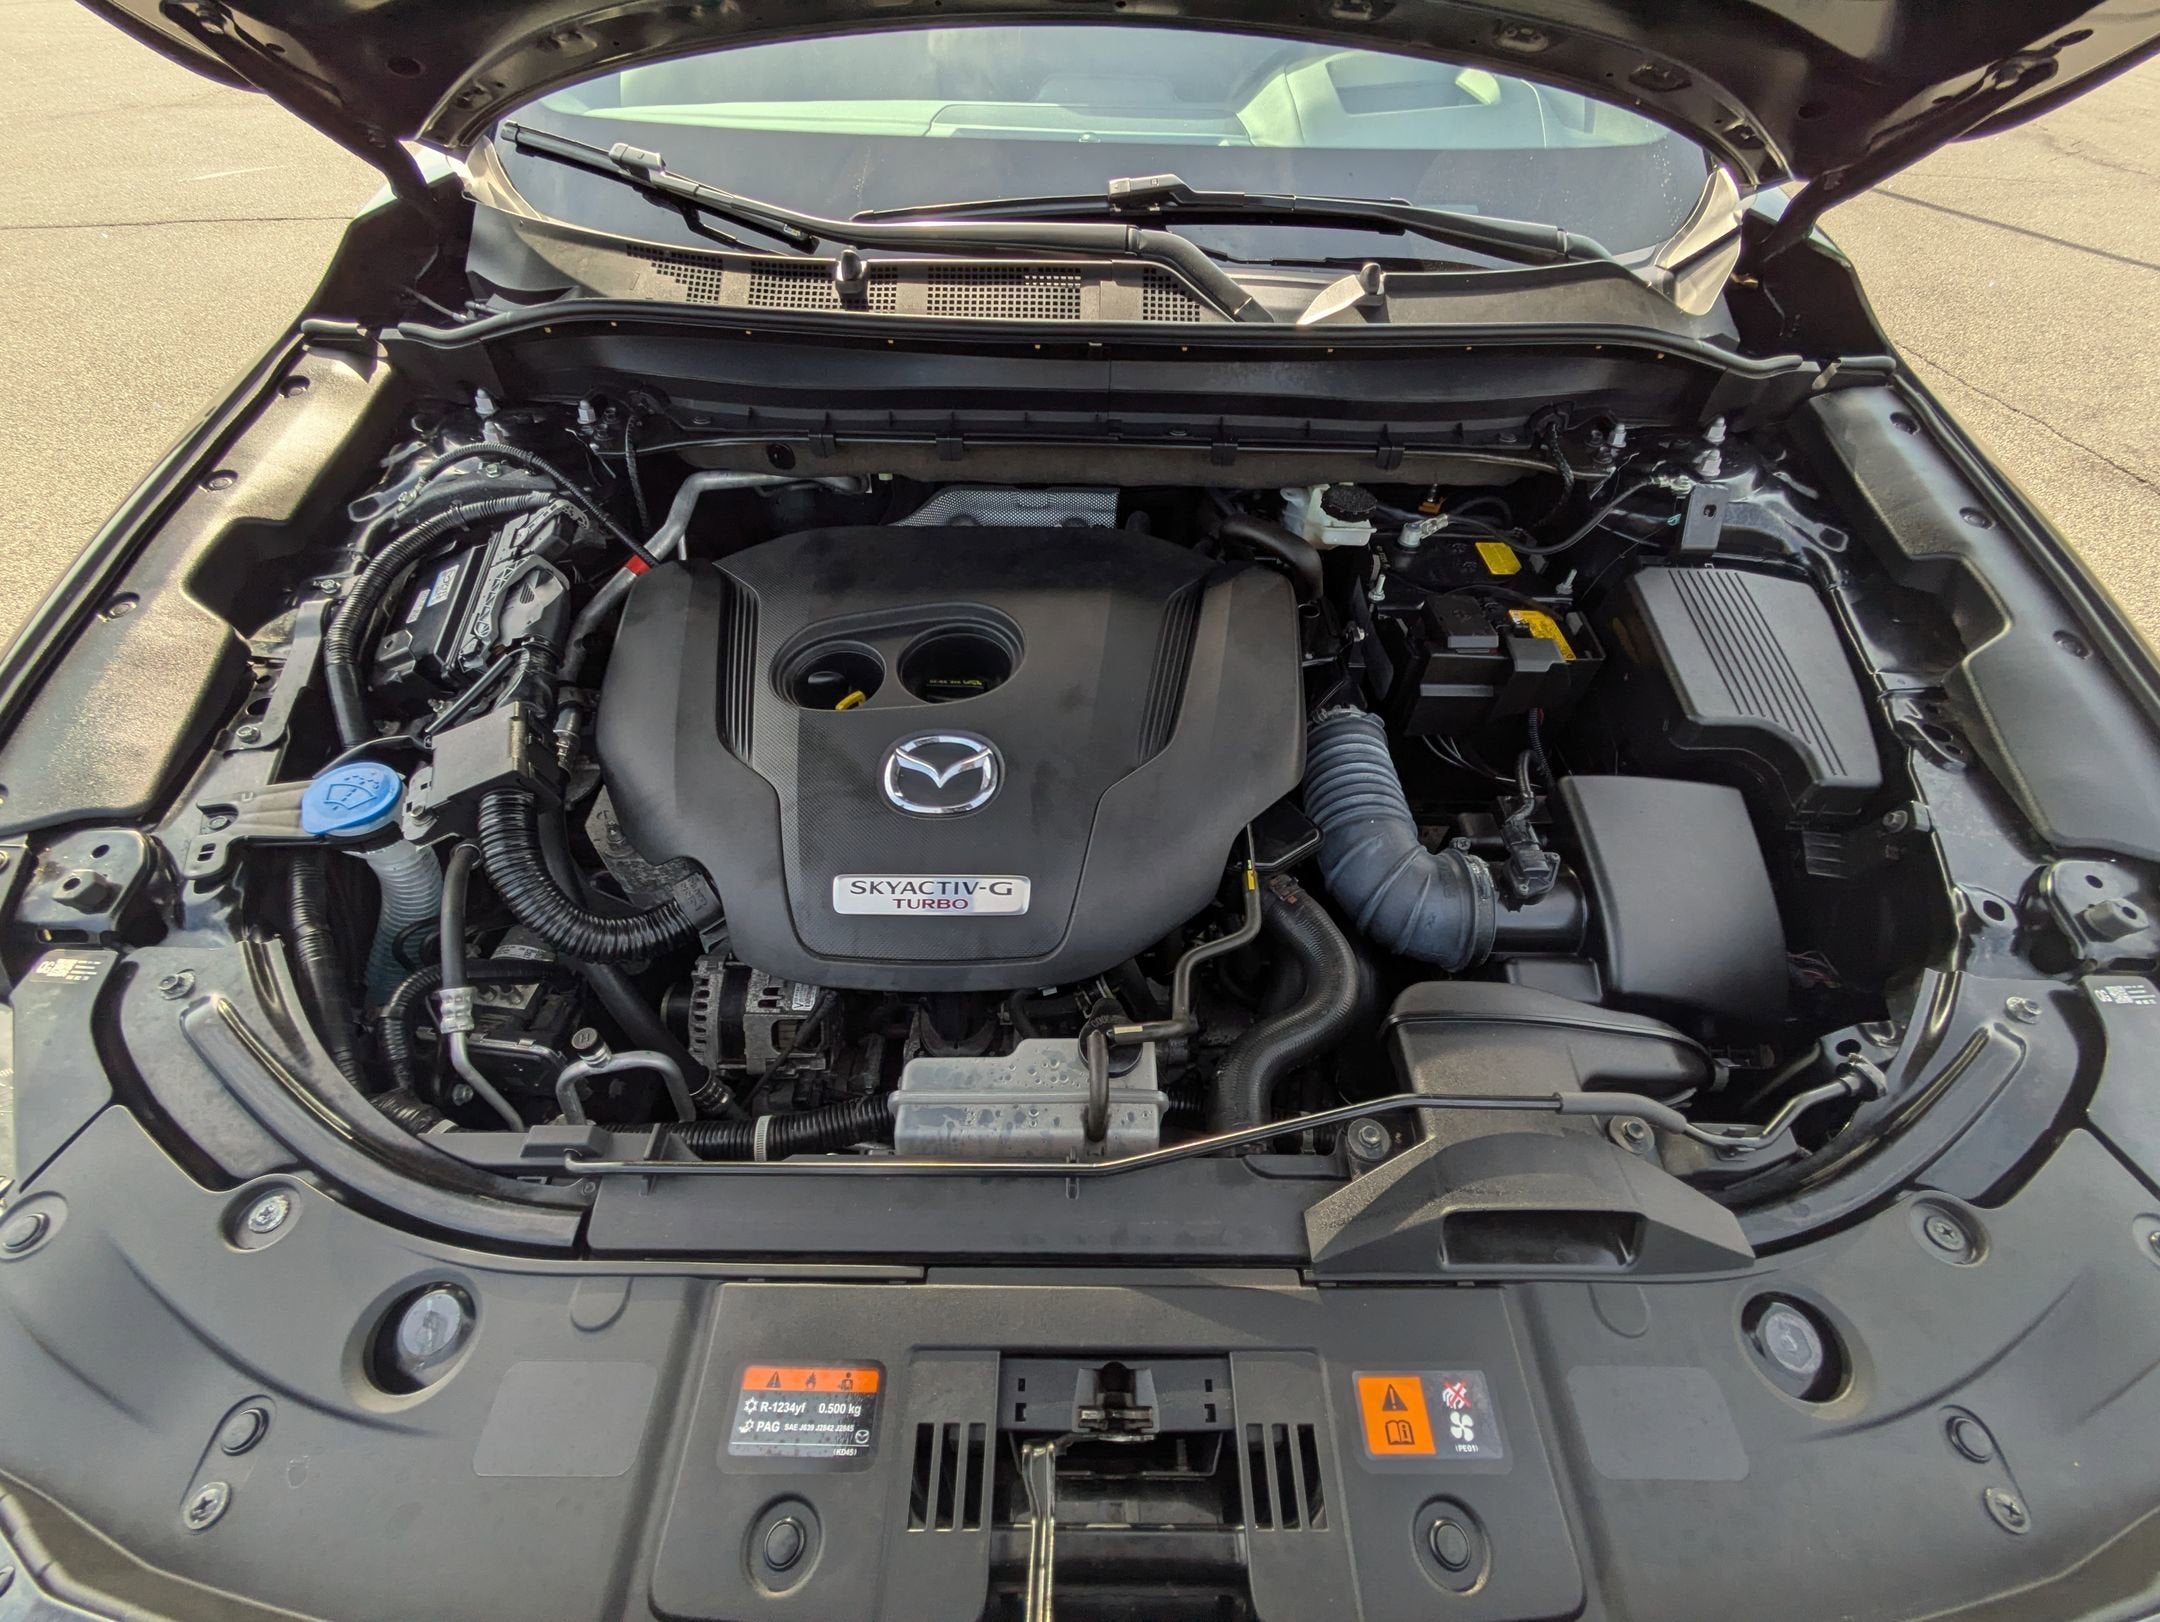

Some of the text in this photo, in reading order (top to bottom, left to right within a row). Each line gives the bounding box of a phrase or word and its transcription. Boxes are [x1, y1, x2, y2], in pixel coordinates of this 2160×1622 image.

[850, 880, 1012, 896] SKYACTIV-G
[893, 898, 968, 909] TURBO
[760, 1402, 861, 1417] R-1234yf 0.500 kg
[756, 1421, 780, 1432] PAG
